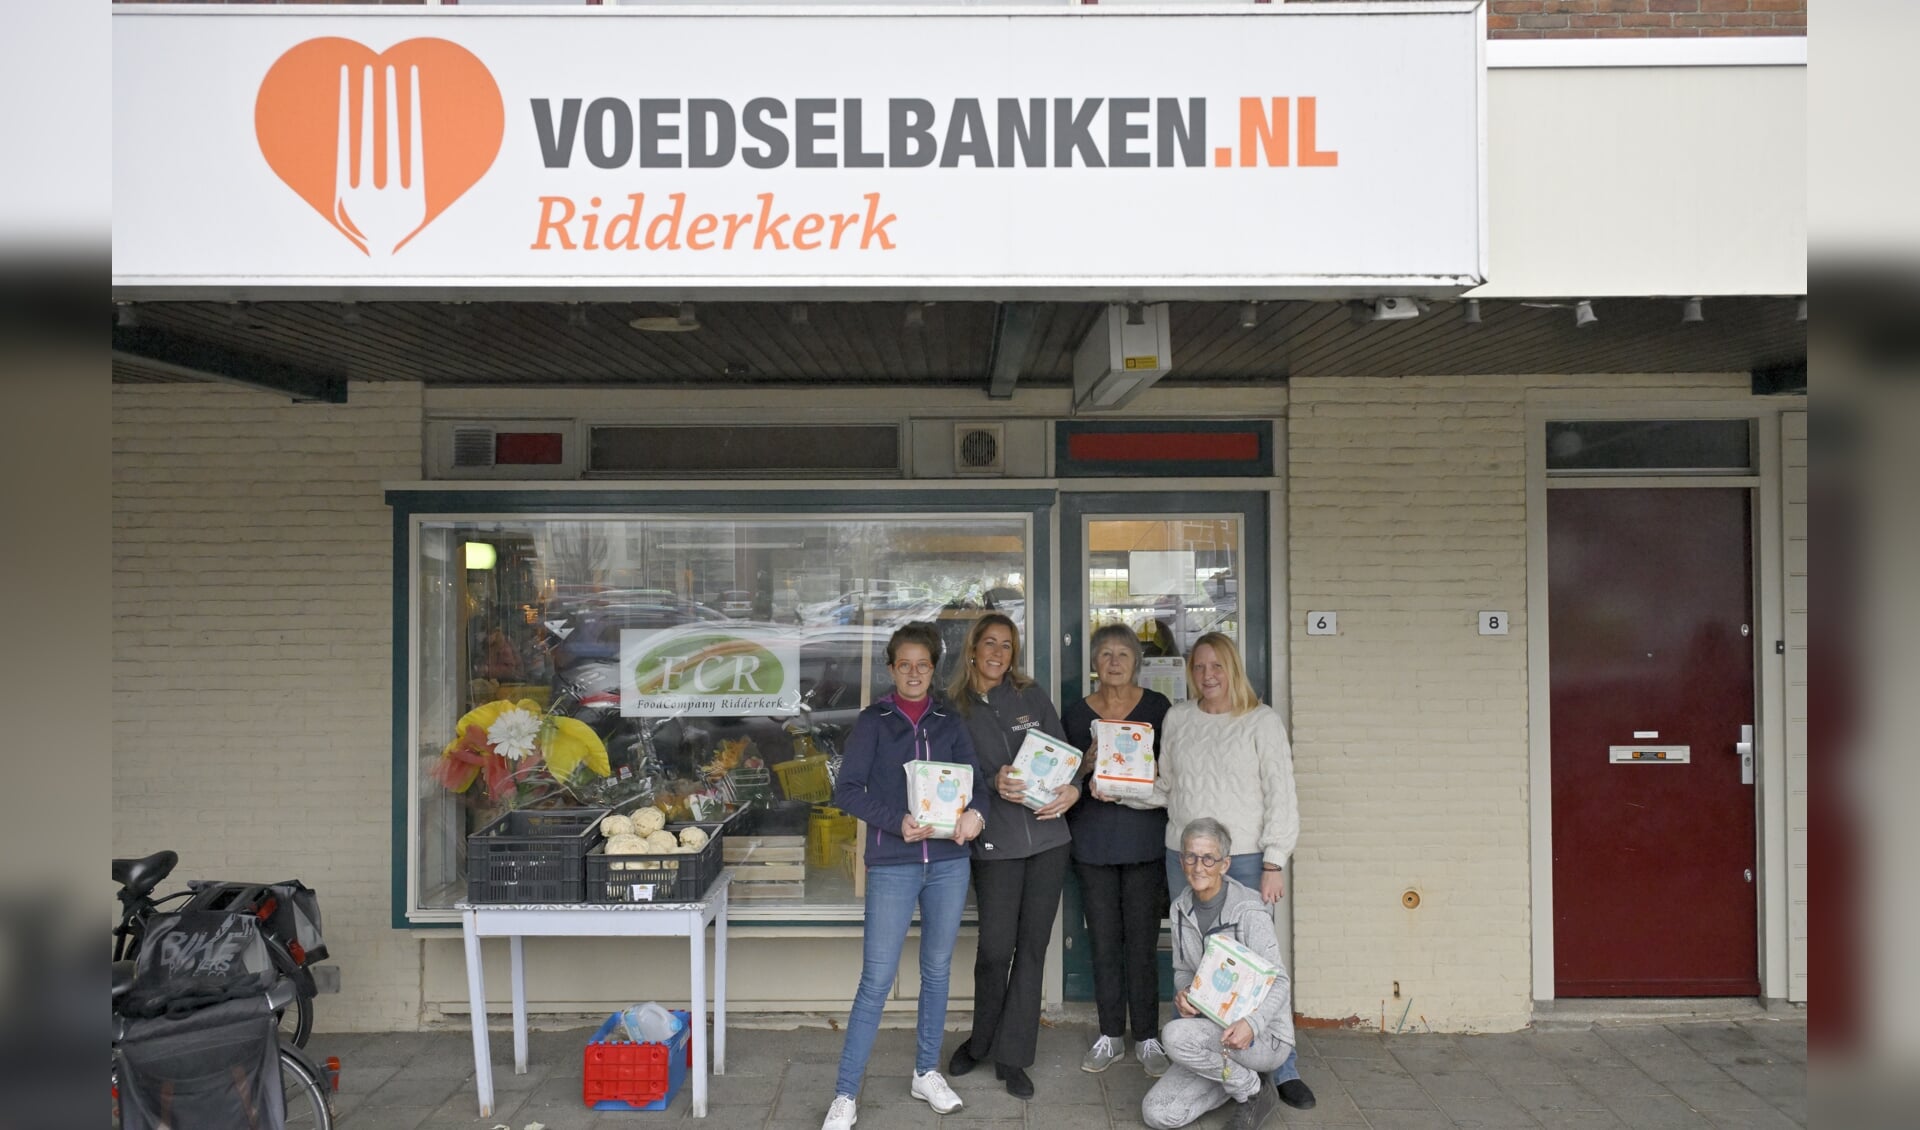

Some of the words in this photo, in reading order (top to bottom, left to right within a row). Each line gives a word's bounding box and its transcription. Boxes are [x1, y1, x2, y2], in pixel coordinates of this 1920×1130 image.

[530, 97, 1337, 169] VOEDSELBANKEN.NL
[530, 192, 896, 251] Ridderkerk
[1316, 616, 1327, 630] 6
[1488, 616, 1500, 630] 8
[655, 654, 764, 694] FCR
[636, 698, 717, 713] FoodCompany
[720, 696, 784, 709] Ridderkerk
